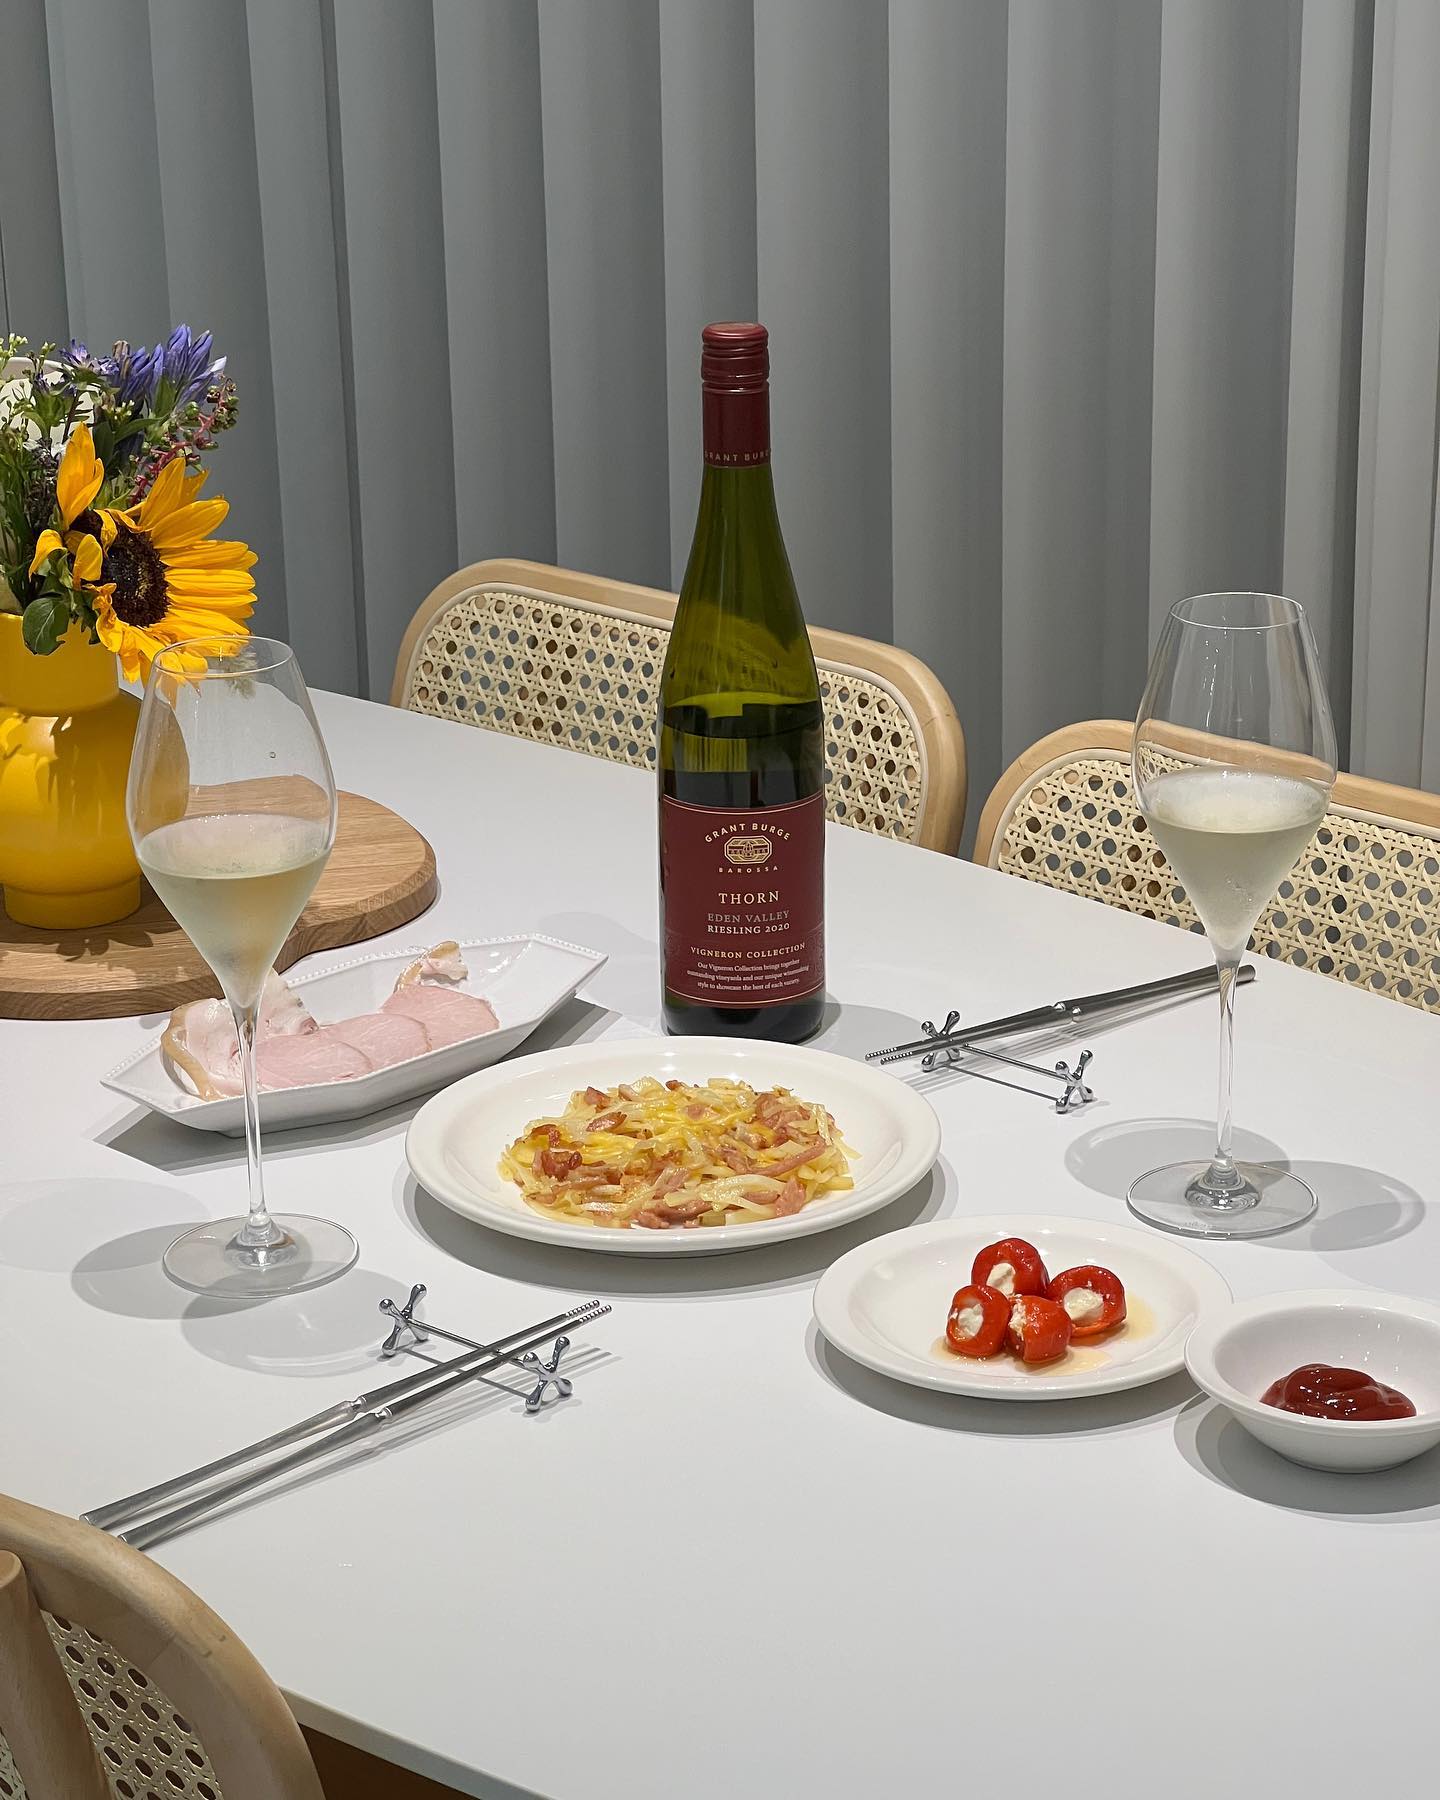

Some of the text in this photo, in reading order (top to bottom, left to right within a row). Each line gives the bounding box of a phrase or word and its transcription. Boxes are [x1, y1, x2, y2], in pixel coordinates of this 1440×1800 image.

[705, 823, 791, 843] GRANT BURGE
[718, 866, 779, 874] BAROSSA
[718, 890, 780, 905] THORN
[707, 910, 790, 923] EDEN VALLEY
[707, 922, 790, 935] RIESLING 2020
[690, 942, 806, 959] VIGNERON COLLECTION
[697, 962, 708, 970] Our
[708, 963, 734, 972] Vigneron
[763, 963, 780, 972] brings
[780, 959, 800, 969] together
[716, 982, 742, 991] showcase
[771, 981, 783, 989] each
